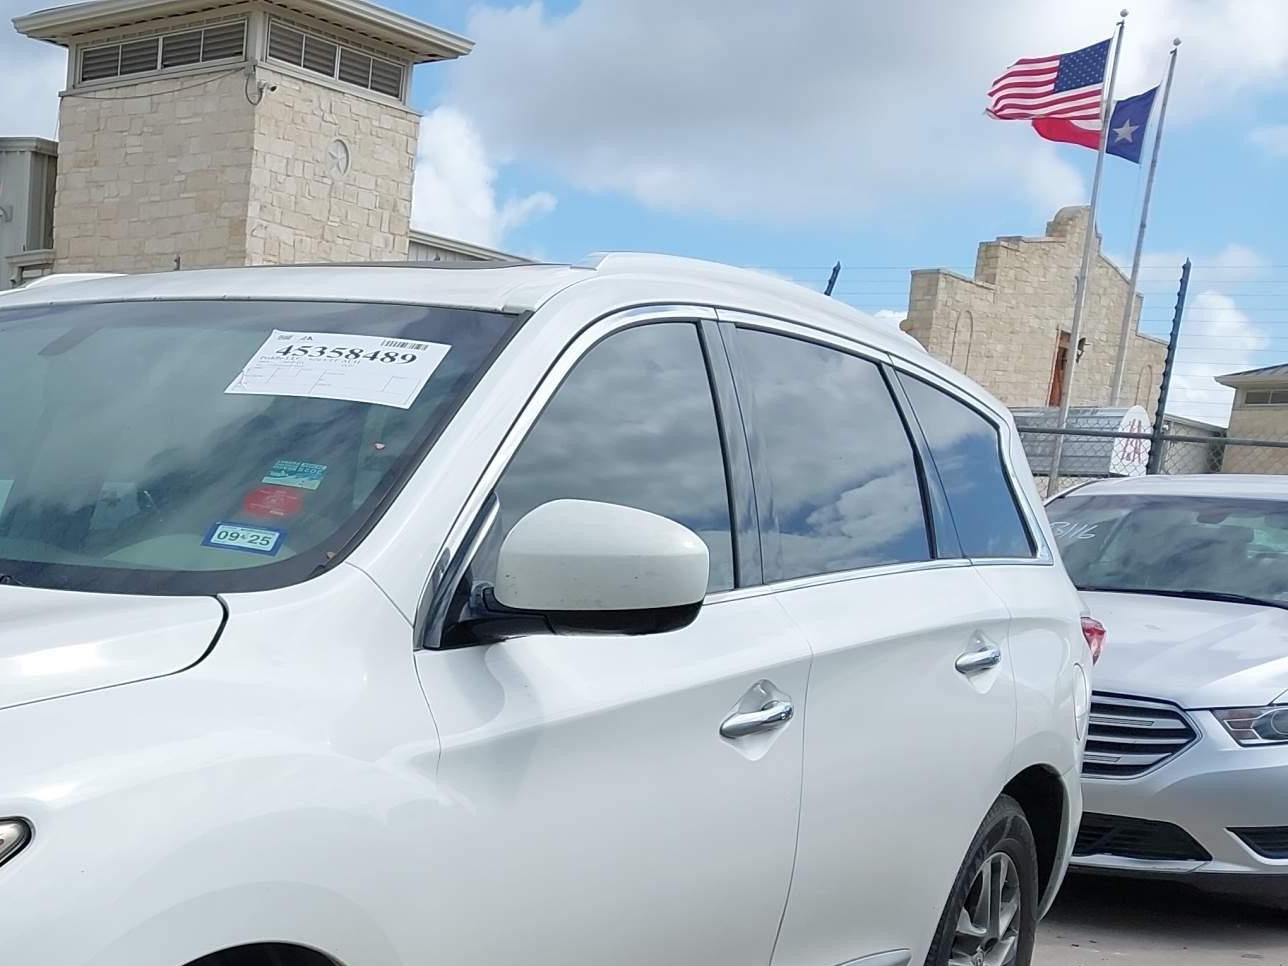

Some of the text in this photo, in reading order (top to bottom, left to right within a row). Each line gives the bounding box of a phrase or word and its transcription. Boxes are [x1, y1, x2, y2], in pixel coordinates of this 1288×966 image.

[275, 344, 417, 365] 45358489
[216, 530, 272, 546] 09 25
